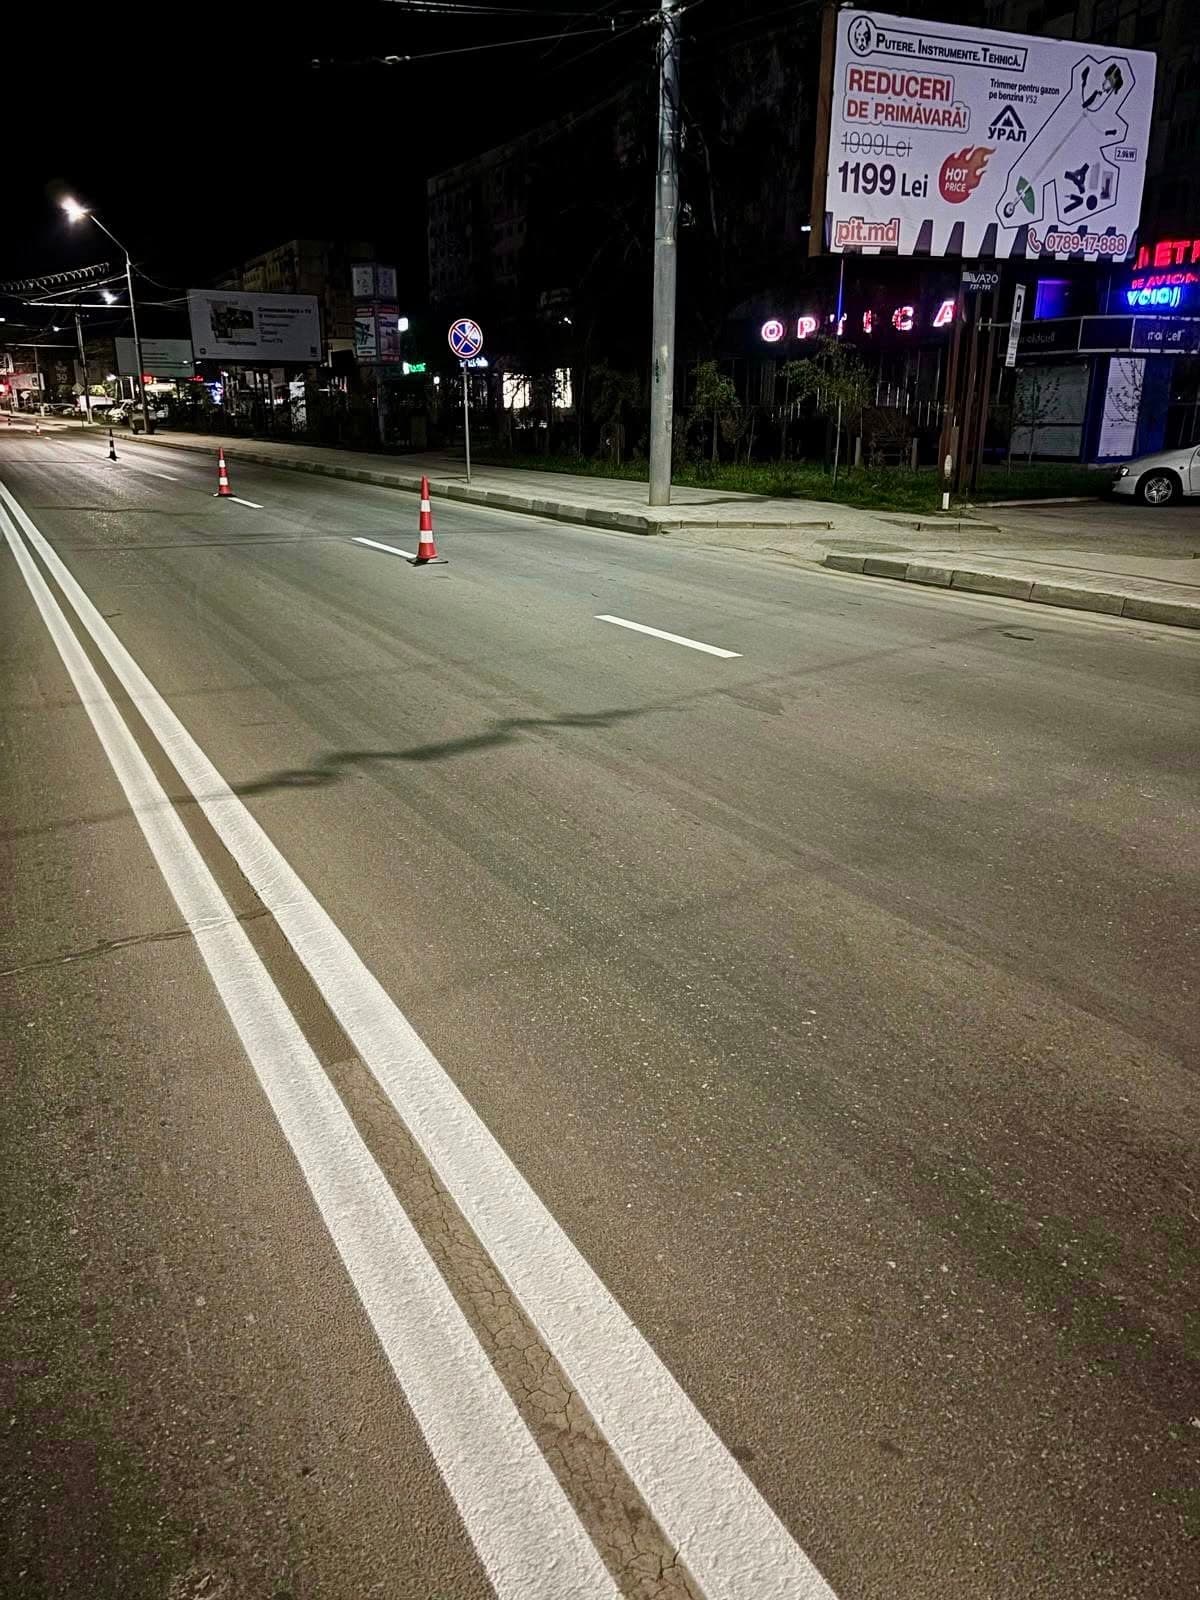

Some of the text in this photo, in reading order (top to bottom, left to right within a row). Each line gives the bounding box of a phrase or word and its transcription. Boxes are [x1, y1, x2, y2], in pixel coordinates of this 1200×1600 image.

[849, 68, 951, 101] REDUCERI
[990, 78, 1060, 96] Trimmer pentru gazon
[989, 91, 998, 100] pe
[847, 100, 967, 128] DE PRIMĂVARĂ!
[987, 126, 1027, 143] УРАЛ
[838, 160, 929, 198] 1199 Lei
[945, 167, 969, 181] HOT
[944, 182, 967, 193] PRICE
[837, 217, 898, 243] pit.md
[1046, 234, 1126, 253] 0789-17-888
[761, 300, 956, 342] OPTICA
